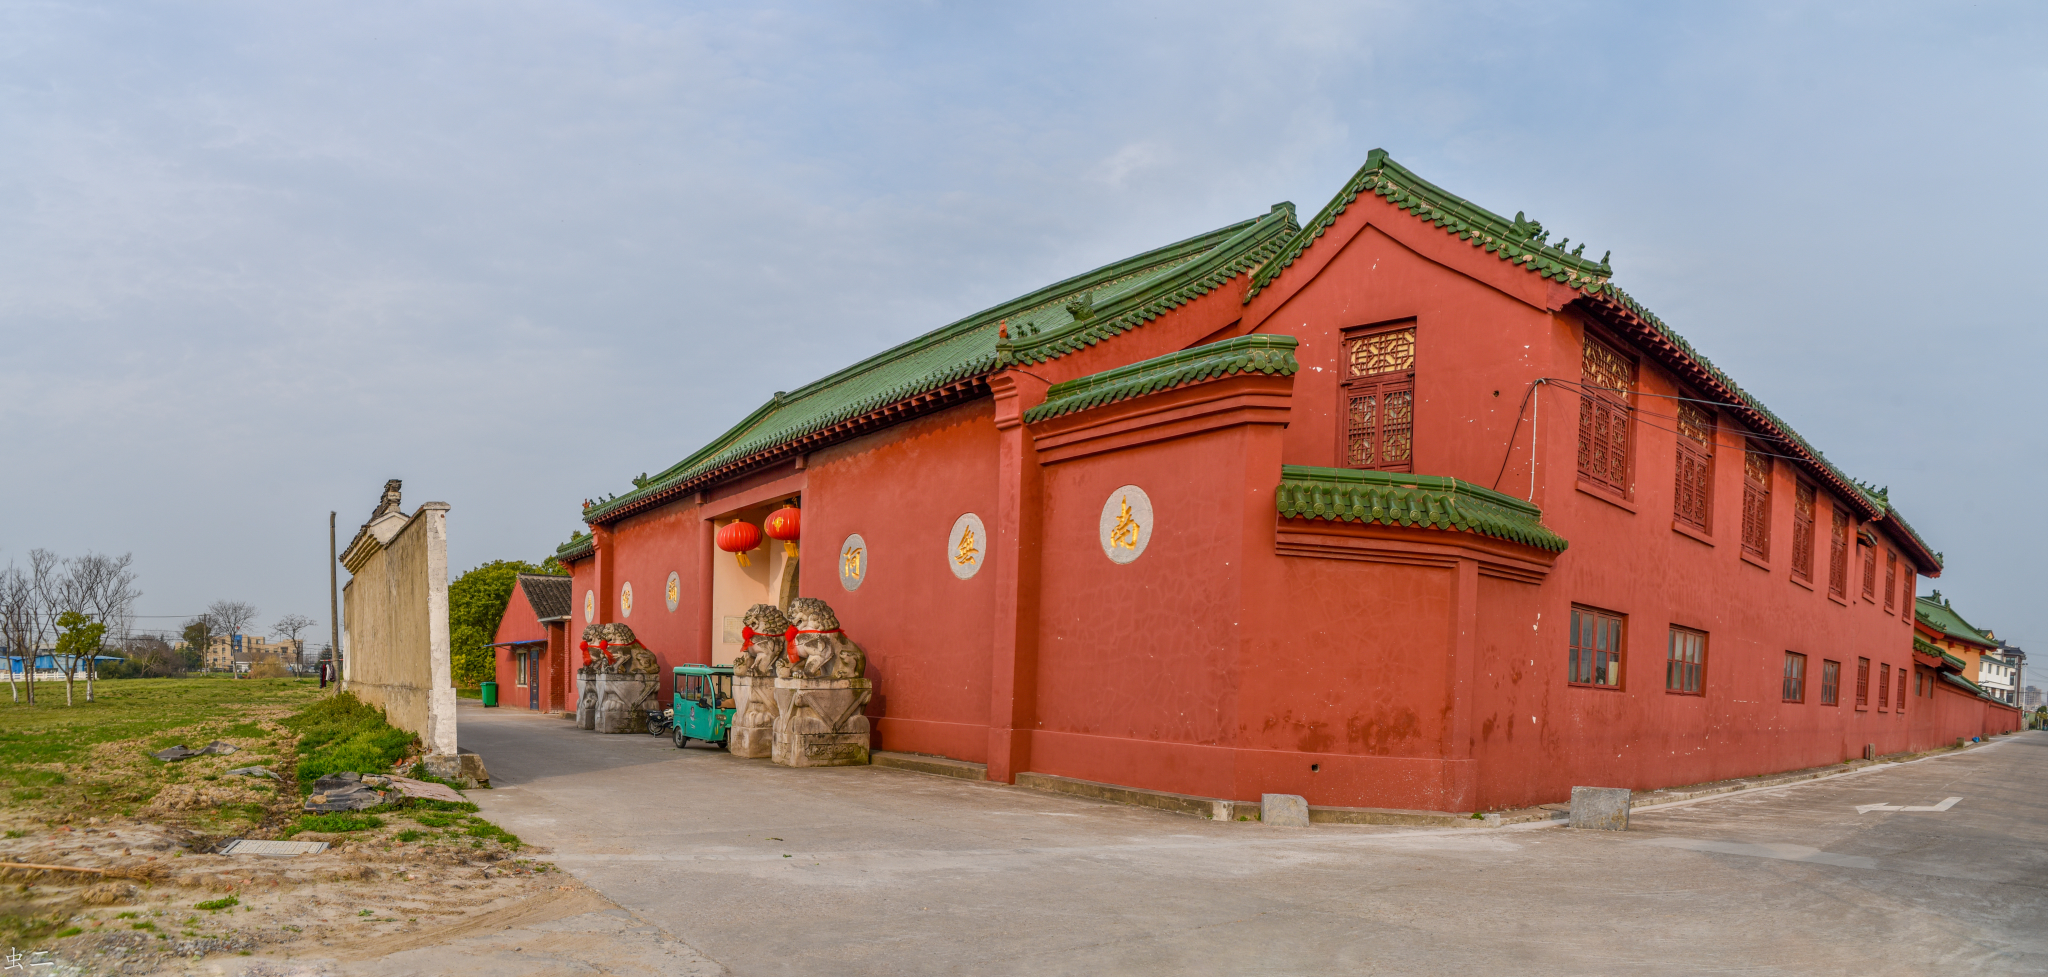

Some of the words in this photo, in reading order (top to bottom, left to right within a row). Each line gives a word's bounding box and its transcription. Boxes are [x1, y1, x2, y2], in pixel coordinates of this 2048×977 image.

[1110, 495, 1140, 550] 南
[843, 547, 863, 580] 阿
[954, 525, 979, 566] 無
